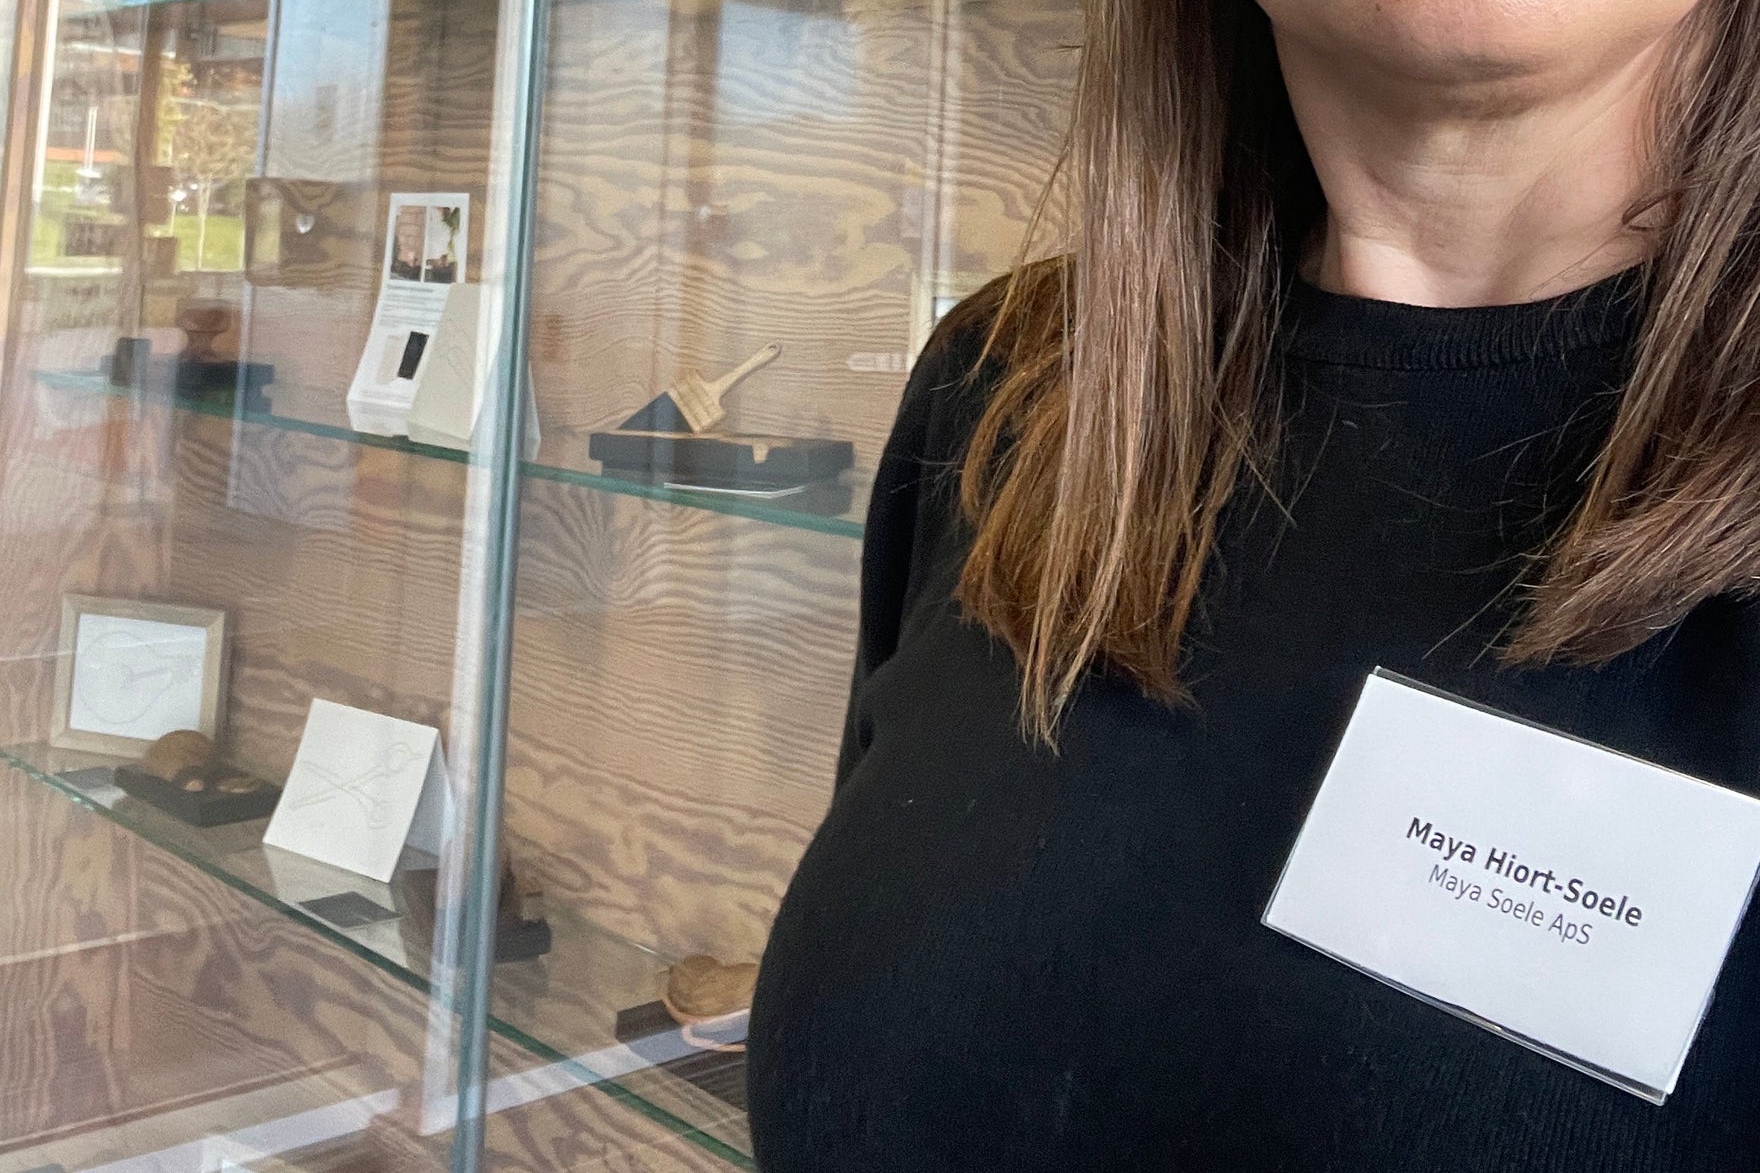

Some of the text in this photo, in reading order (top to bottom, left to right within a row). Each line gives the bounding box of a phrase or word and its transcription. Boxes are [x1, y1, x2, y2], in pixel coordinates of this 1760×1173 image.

[1406, 816, 1643, 927] Maya Hiort-Soele
[1428, 864, 1593, 945] Maya Soele ApS
